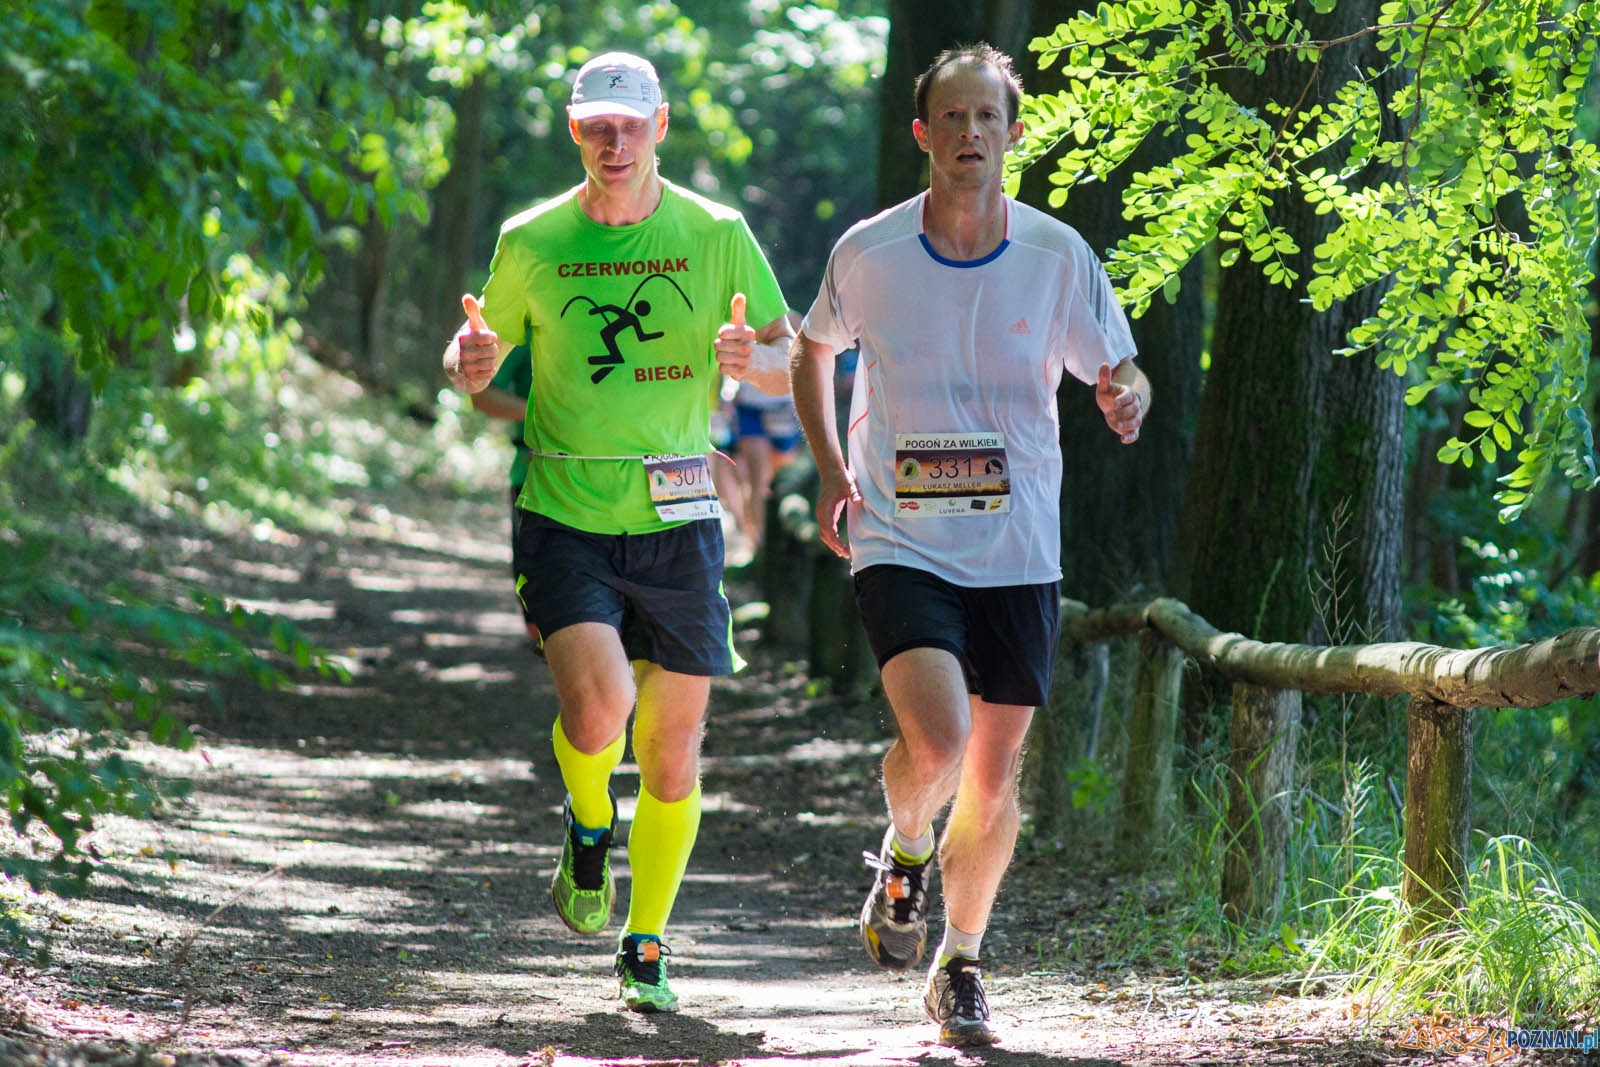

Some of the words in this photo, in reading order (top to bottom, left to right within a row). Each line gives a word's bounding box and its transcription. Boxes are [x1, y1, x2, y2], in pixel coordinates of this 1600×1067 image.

[557, 258, 689, 278] CZERWONAK
[634, 365, 694, 382] BIEGA
[905, 438, 941, 449] POGOŃ
[943, 439, 957, 448] ZA
[959, 438, 999, 448] WILKIEM
[672, 464, 703, 487] 307
[928, 456, 972, 479] 331
[953, 481, 982, 489] MELLER
